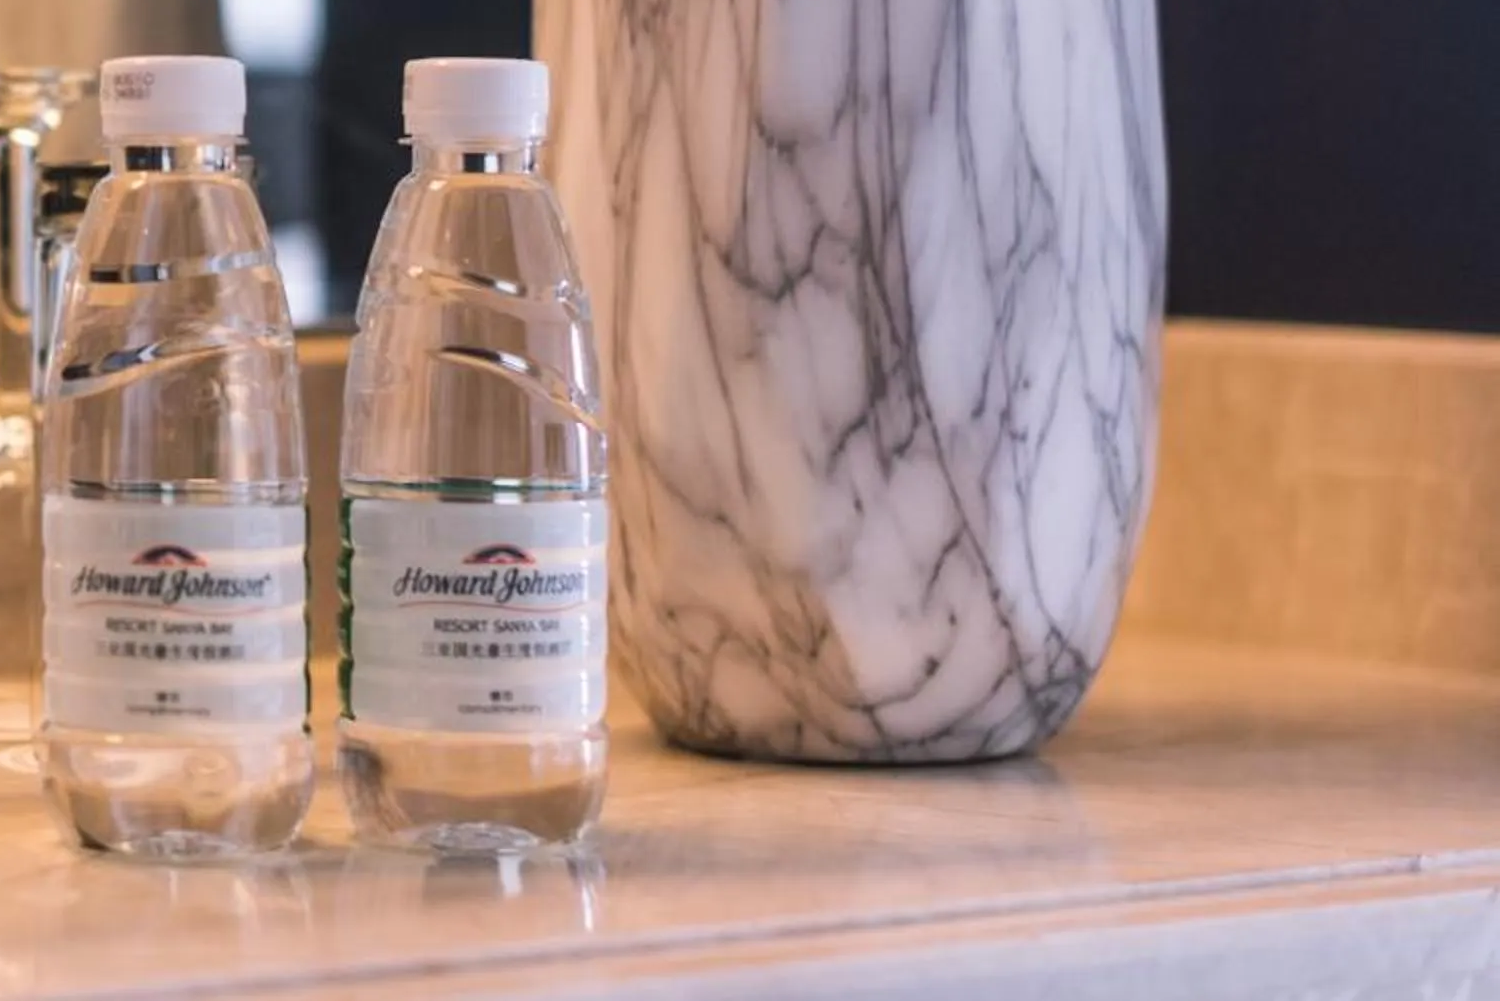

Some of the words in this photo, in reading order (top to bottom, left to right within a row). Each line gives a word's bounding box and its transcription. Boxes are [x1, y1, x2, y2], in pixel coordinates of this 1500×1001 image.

[72, 566, 165, 597] Howard
[162, 568, 265, 604] Johnson
[392, 566, 497, 597] Howard
[433, 618, 488, 633] RESORT
